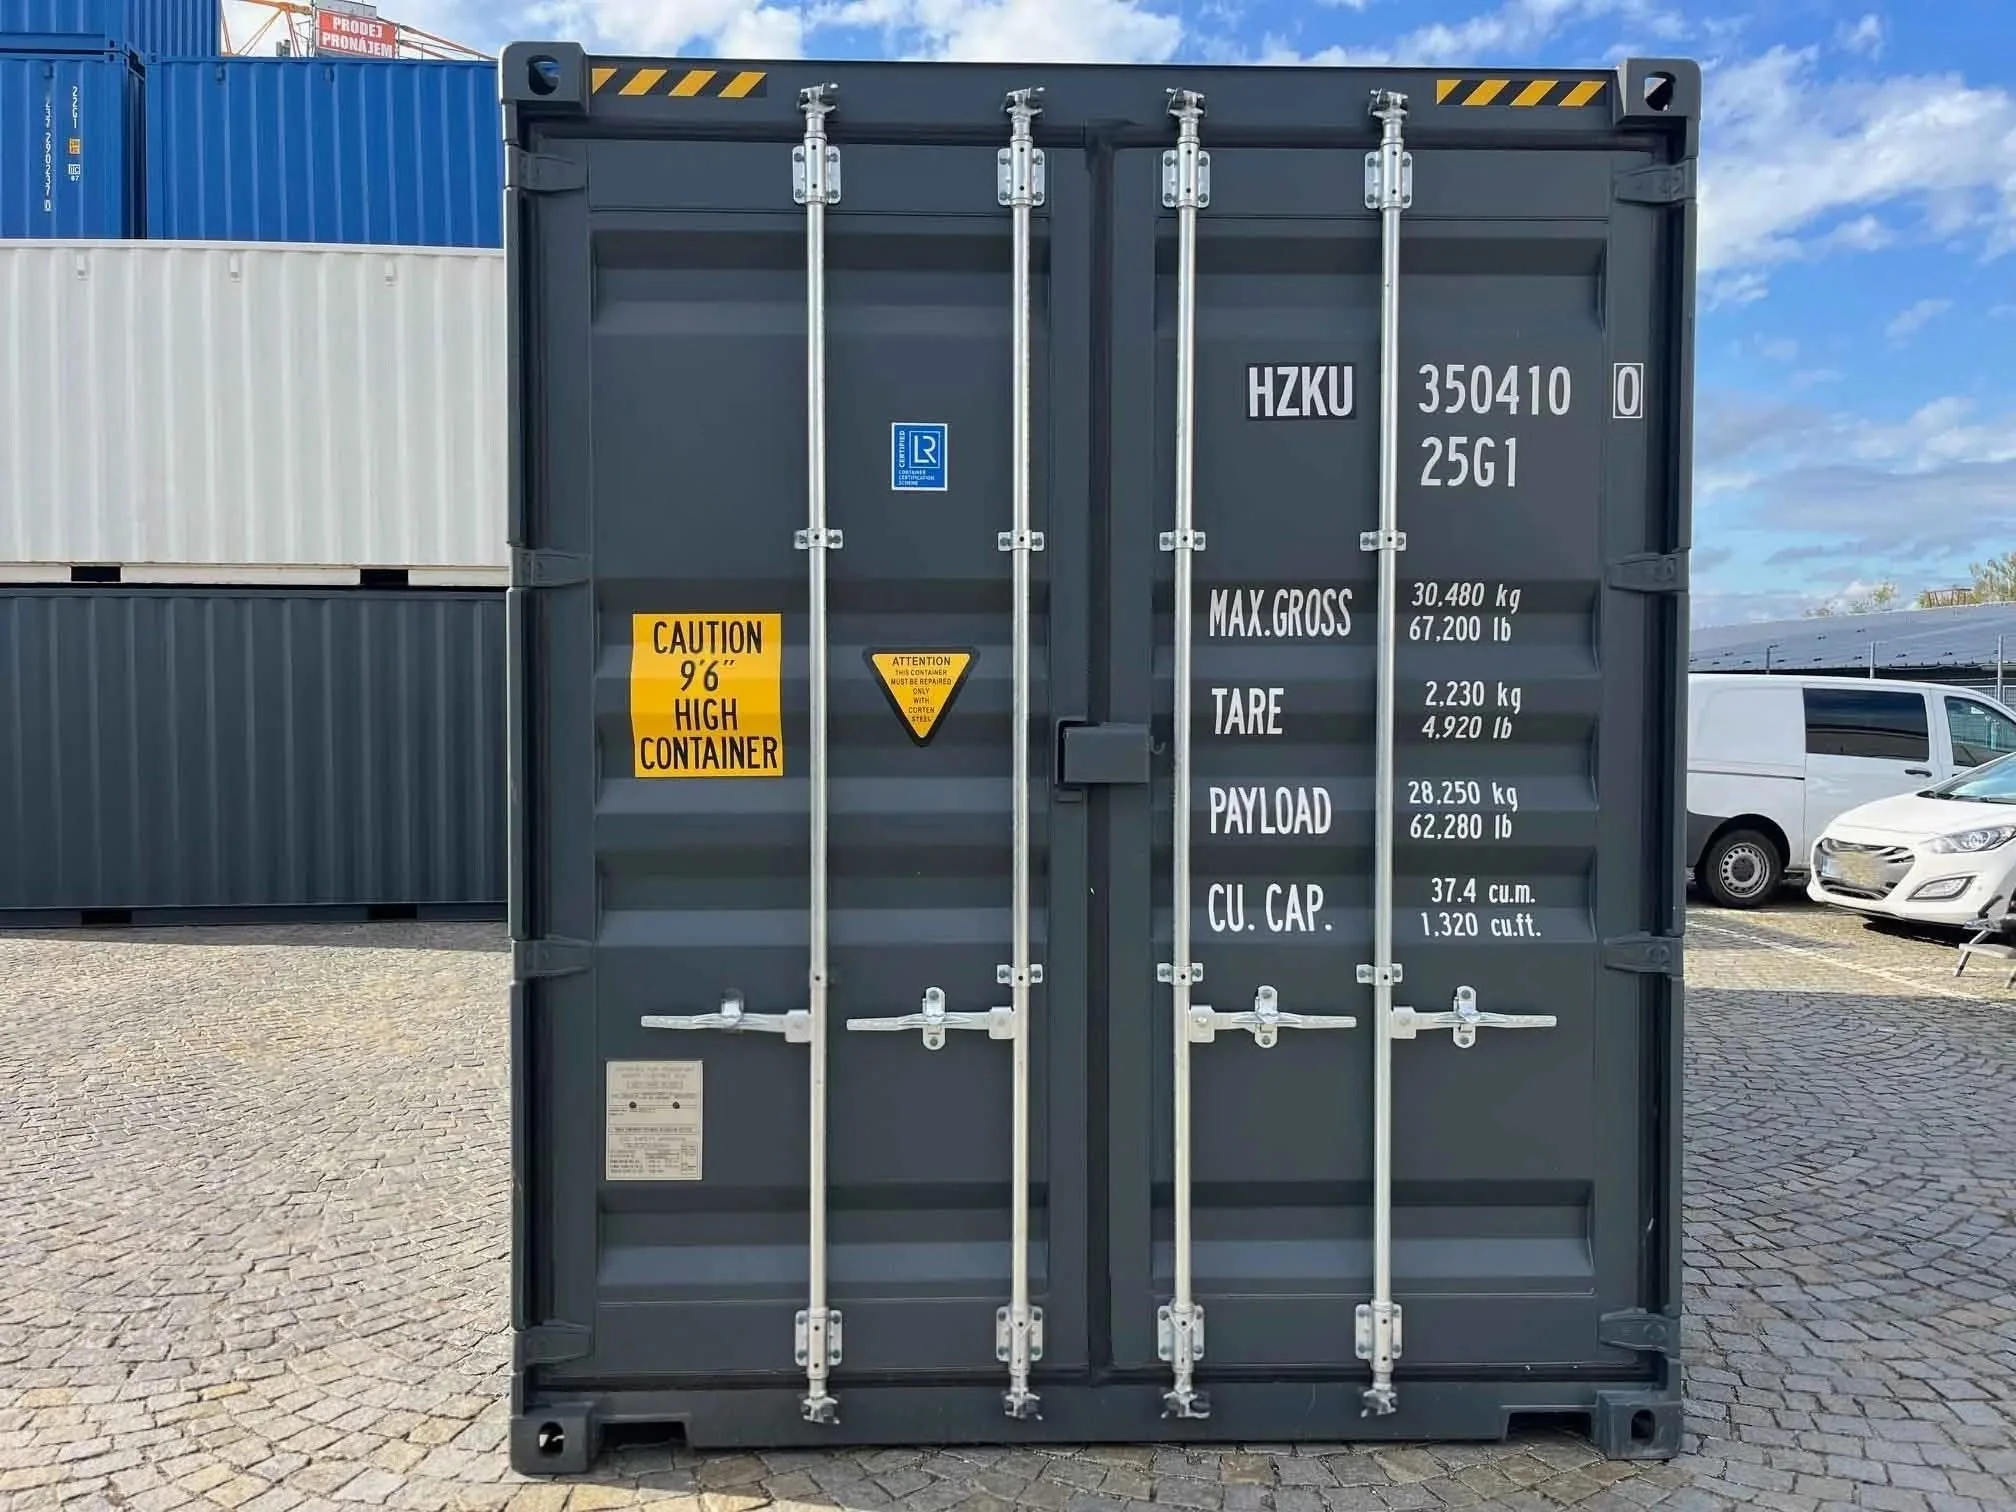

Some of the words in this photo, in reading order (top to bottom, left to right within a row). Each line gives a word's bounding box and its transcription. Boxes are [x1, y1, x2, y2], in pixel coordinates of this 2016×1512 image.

[332, 15, 383, 38] PRODEJ
[322, 31, 393, 58] PRONÁJEM
[1248, 365, 1354, 417] HZKU
[1417, 364, 1572, 416] 350410
[1616, 365, 1640, 416] 0
[914, 435, 937, 464] LR
[1420, 436, 1517, 488] 25G1
[1209, 588, 1353, 638] MAX.GROSS
[1495, 583, 1522, 615] kg
[653, 620, 762, 654] CAUTION
[1493, 616, 1512, 642] lb
[892, 656, 951, 666] ATTENTION
[890, 678, 908, 686] MUST
[909, 678, 918, 686] BE
[919, 678, 952, 686] REPAIRED
[912, 687, 930, 695] ONLY
[908, 706, 935, 714] CORTEN
[913, 697, 930, 705] WITH
[1211, 687, 1285, 735] TARE
[1497, 681, 1522, 714] kg
[674, 698, 738, 731] HIGH
[1492, 716, 1513, 739] lb
[640, 736, 778, 770] CONTAINER
[1209, 786, 1332, 835] PAYLOAD
[1491, 781, 1519, 812] kg
[1494, 813, 1513, 840] lb
[1431, 877, 1477, 903] 37.4
[1488, 883, 1536, 904] cu.m.
[1208, 883, 1256, 933] CU.
[1265, 883, 1333, 933] CAP.
[1490, 912, 1542, 937] cu.ft.
